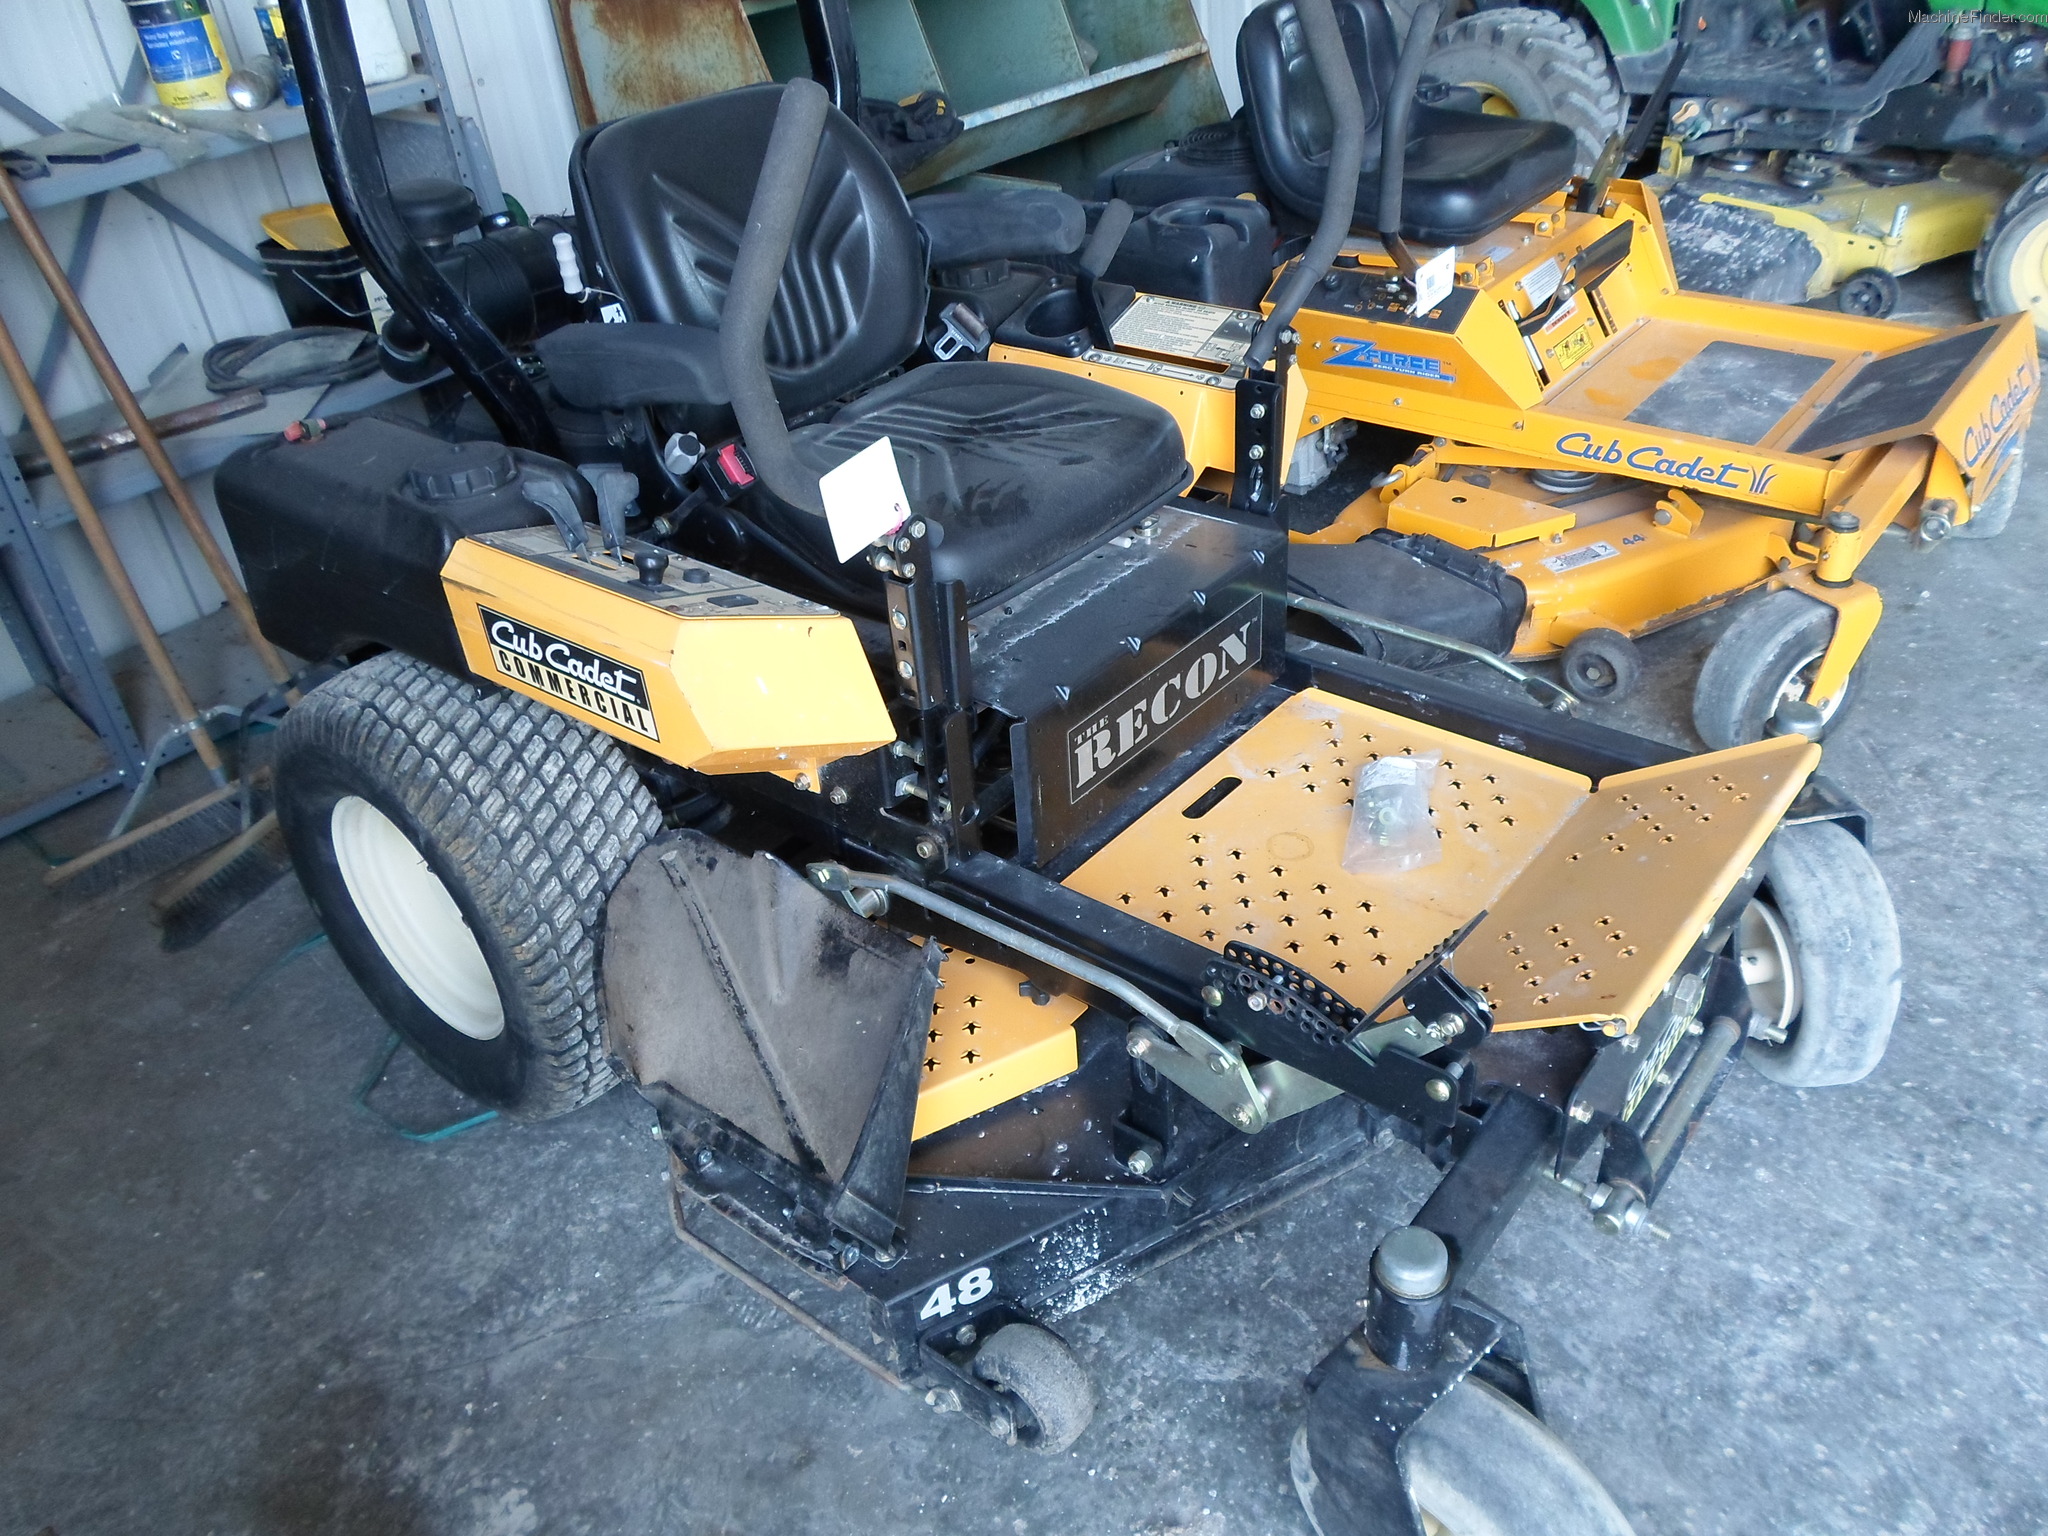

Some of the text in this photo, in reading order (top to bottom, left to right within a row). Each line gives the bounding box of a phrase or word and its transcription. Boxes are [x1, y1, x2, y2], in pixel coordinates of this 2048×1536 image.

[1373, 363, 1441, 379] ZERO TURN RIDER
[1964, 364, 2030, 467] Cub Cadet
[1556, 432, 1749, 489] Cub Cadet
[1622, 534, 1645, 546] 44
[491, 620, 637, 701] Cub Cadet
[498, 649, 649, 733] COMMERCIAL
[1074, 621, 1251, 789] RECON
[1074, 715, 1109, 745] THE
[920, 1267, 994, 1321] 48
